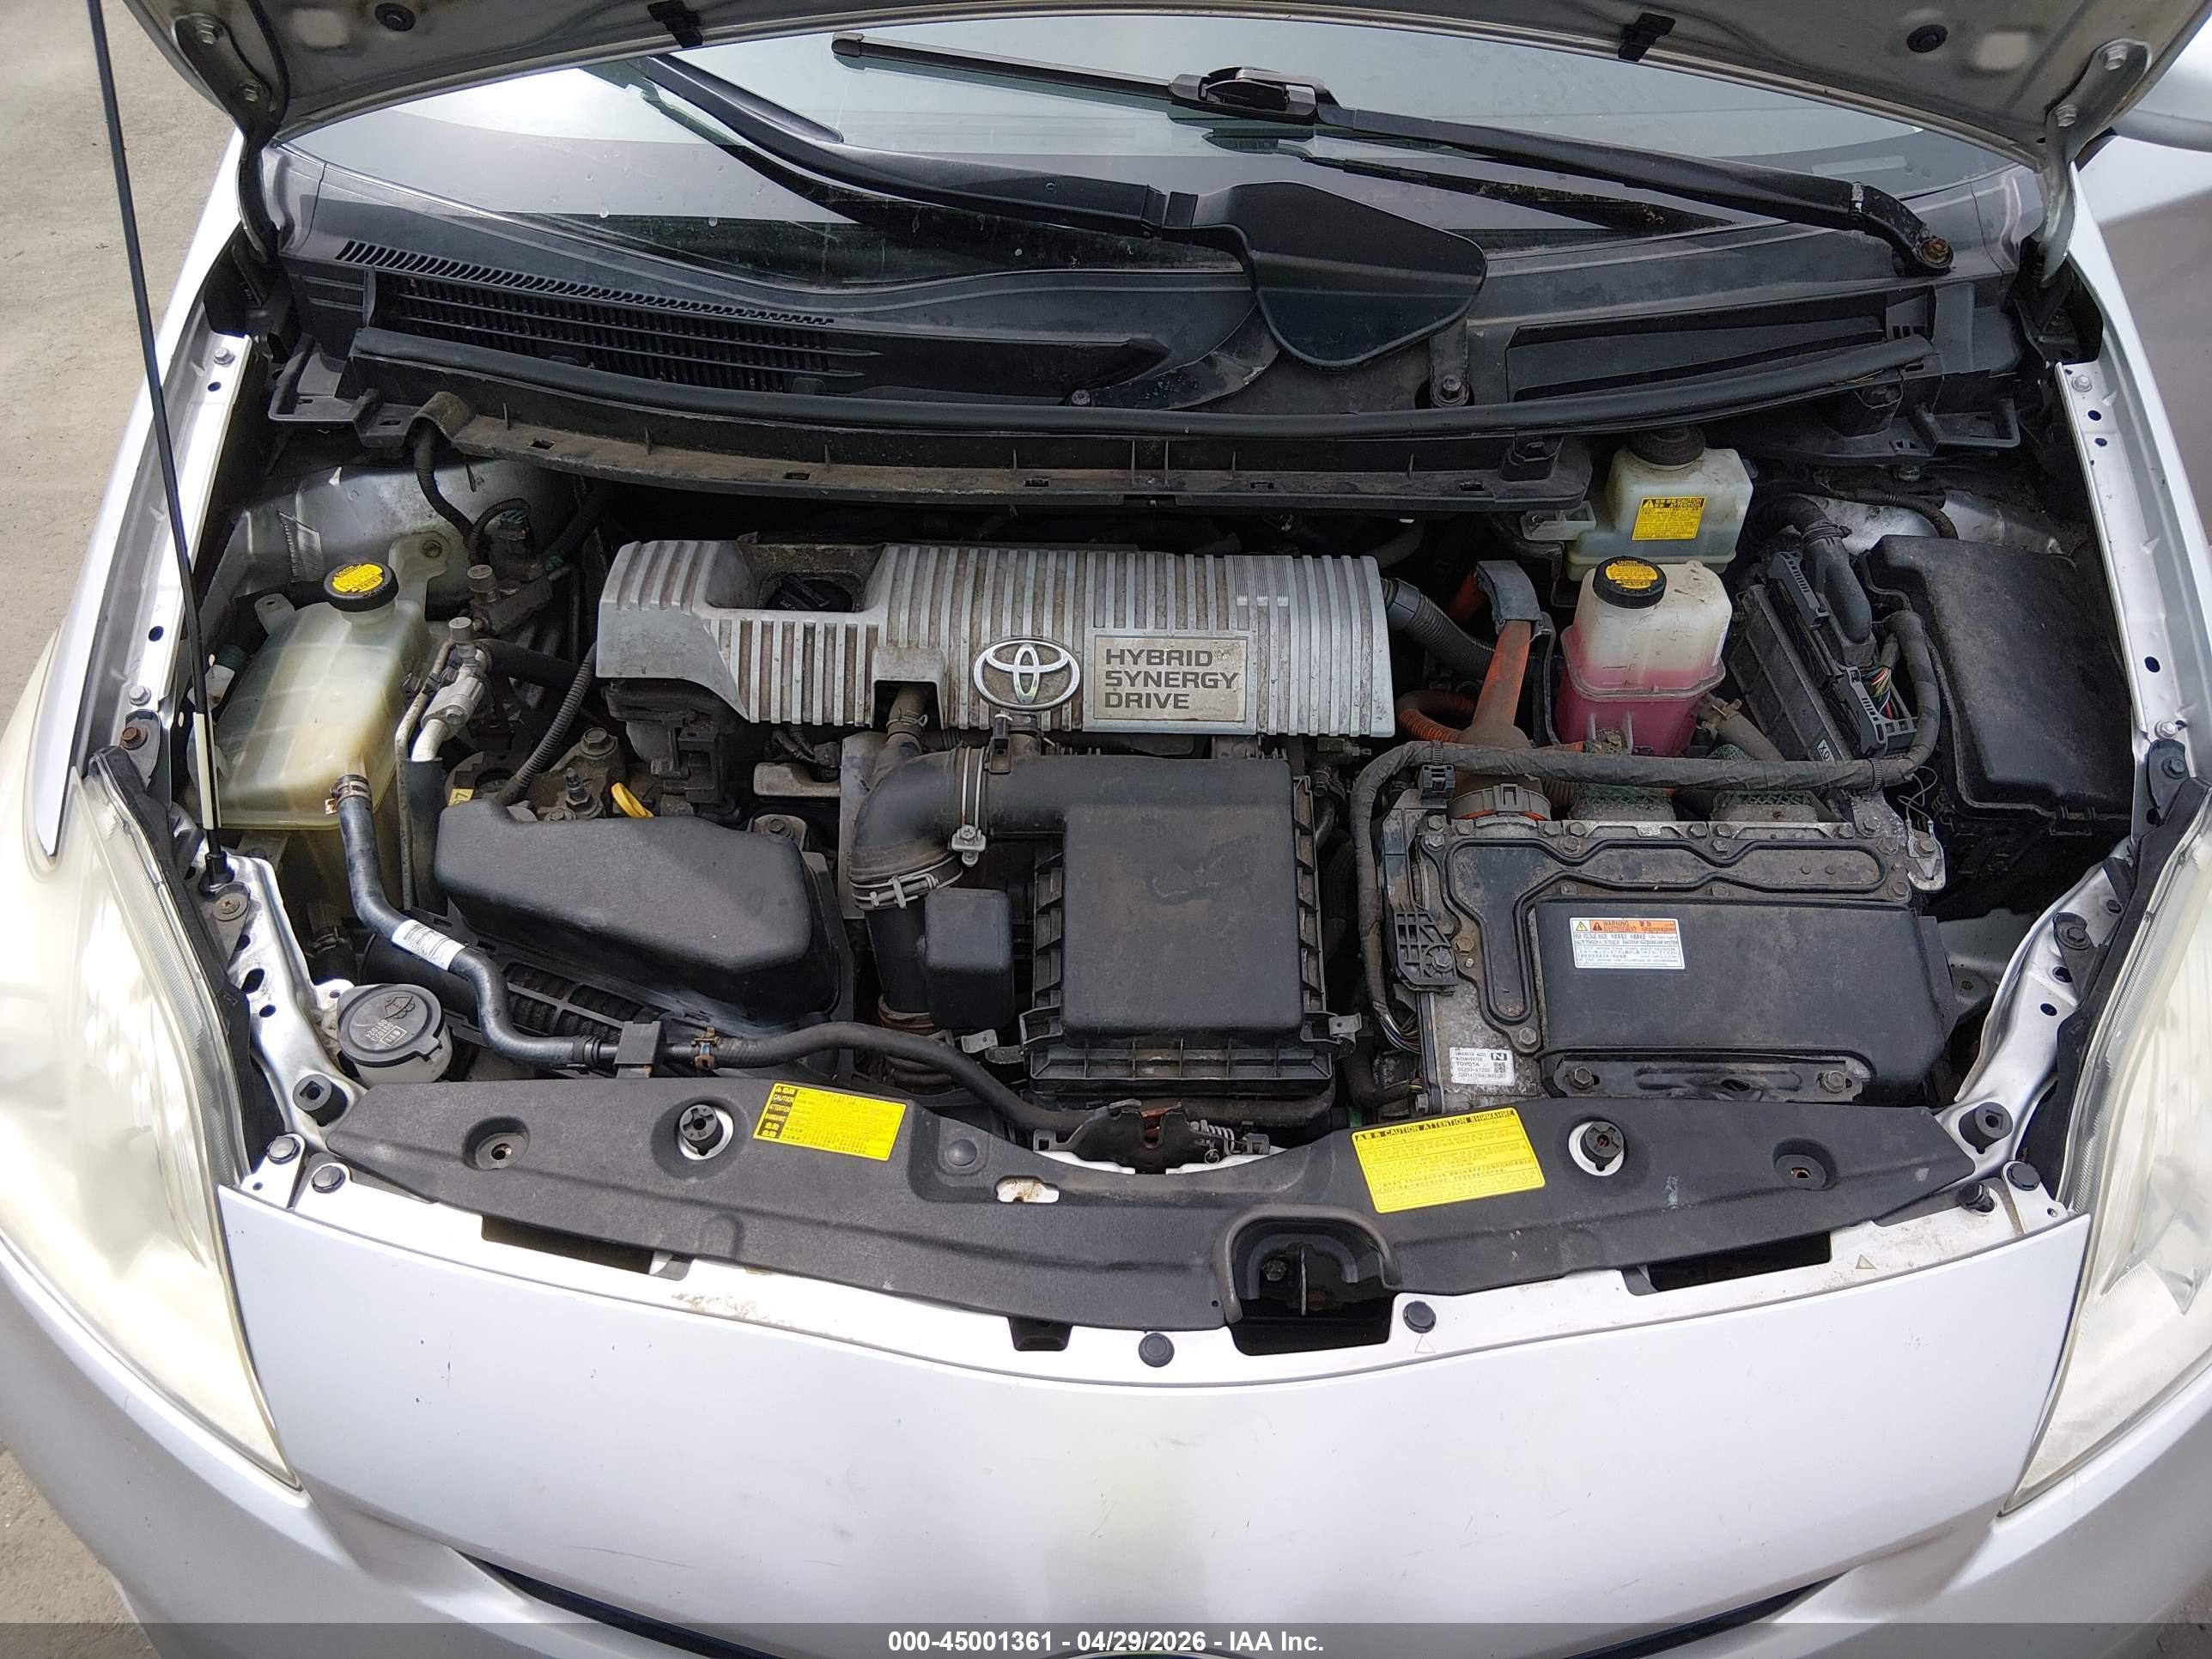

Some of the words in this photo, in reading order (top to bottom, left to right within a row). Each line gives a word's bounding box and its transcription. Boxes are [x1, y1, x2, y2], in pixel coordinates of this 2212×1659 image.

[1105, 648, 1213, 667] HYBRID
[1104, 670, 1239, 690] SYNERGY
[1104, 691, 1190, 709] DRIVE
[772, 1093, 794, 1103] CAUTION
[1470, 1109, 1514, 1123] ВНИМАНИЕ
[1384, 1124, 1420, 1137] CAUTION
[1423, 1117, 1468, 1131] ATTENTION
